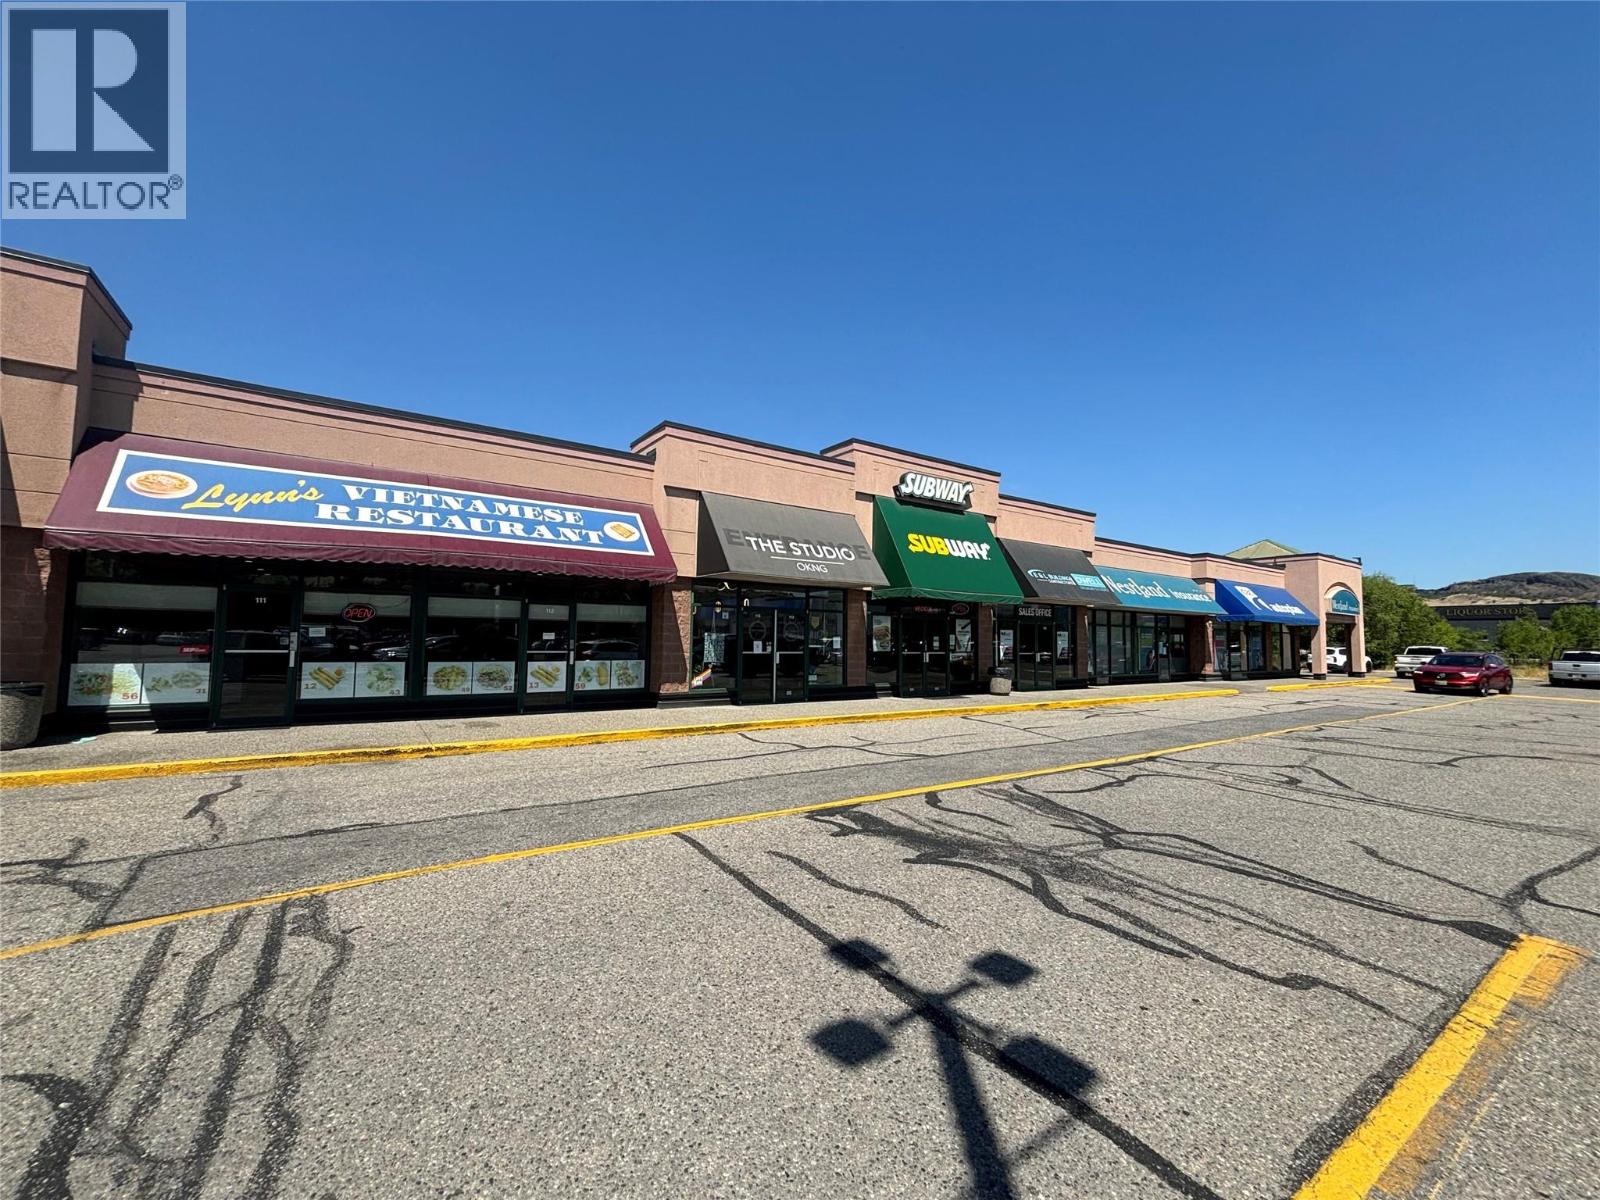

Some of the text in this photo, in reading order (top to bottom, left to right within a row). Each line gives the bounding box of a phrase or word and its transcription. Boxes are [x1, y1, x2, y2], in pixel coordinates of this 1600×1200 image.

[900, 473, 974, 503] SUBWAY
[181, 480, 584, 525] Lynn's VIETNAMESE
[314, 503, 604, 545] RESTAURANT
[745, 536, 856, 561] THE STUDIO
[908, 533, 991, 560] SUBWAY
[796, 562, 828, 573] OKNG
[1100, 574, 1171, 598] Nestland
[343, 608, 373, 618] OPEN
[1018, 607, 1052, 617] SALES OFFICE
[1446, 608, 1491, 616] LIQUOR
